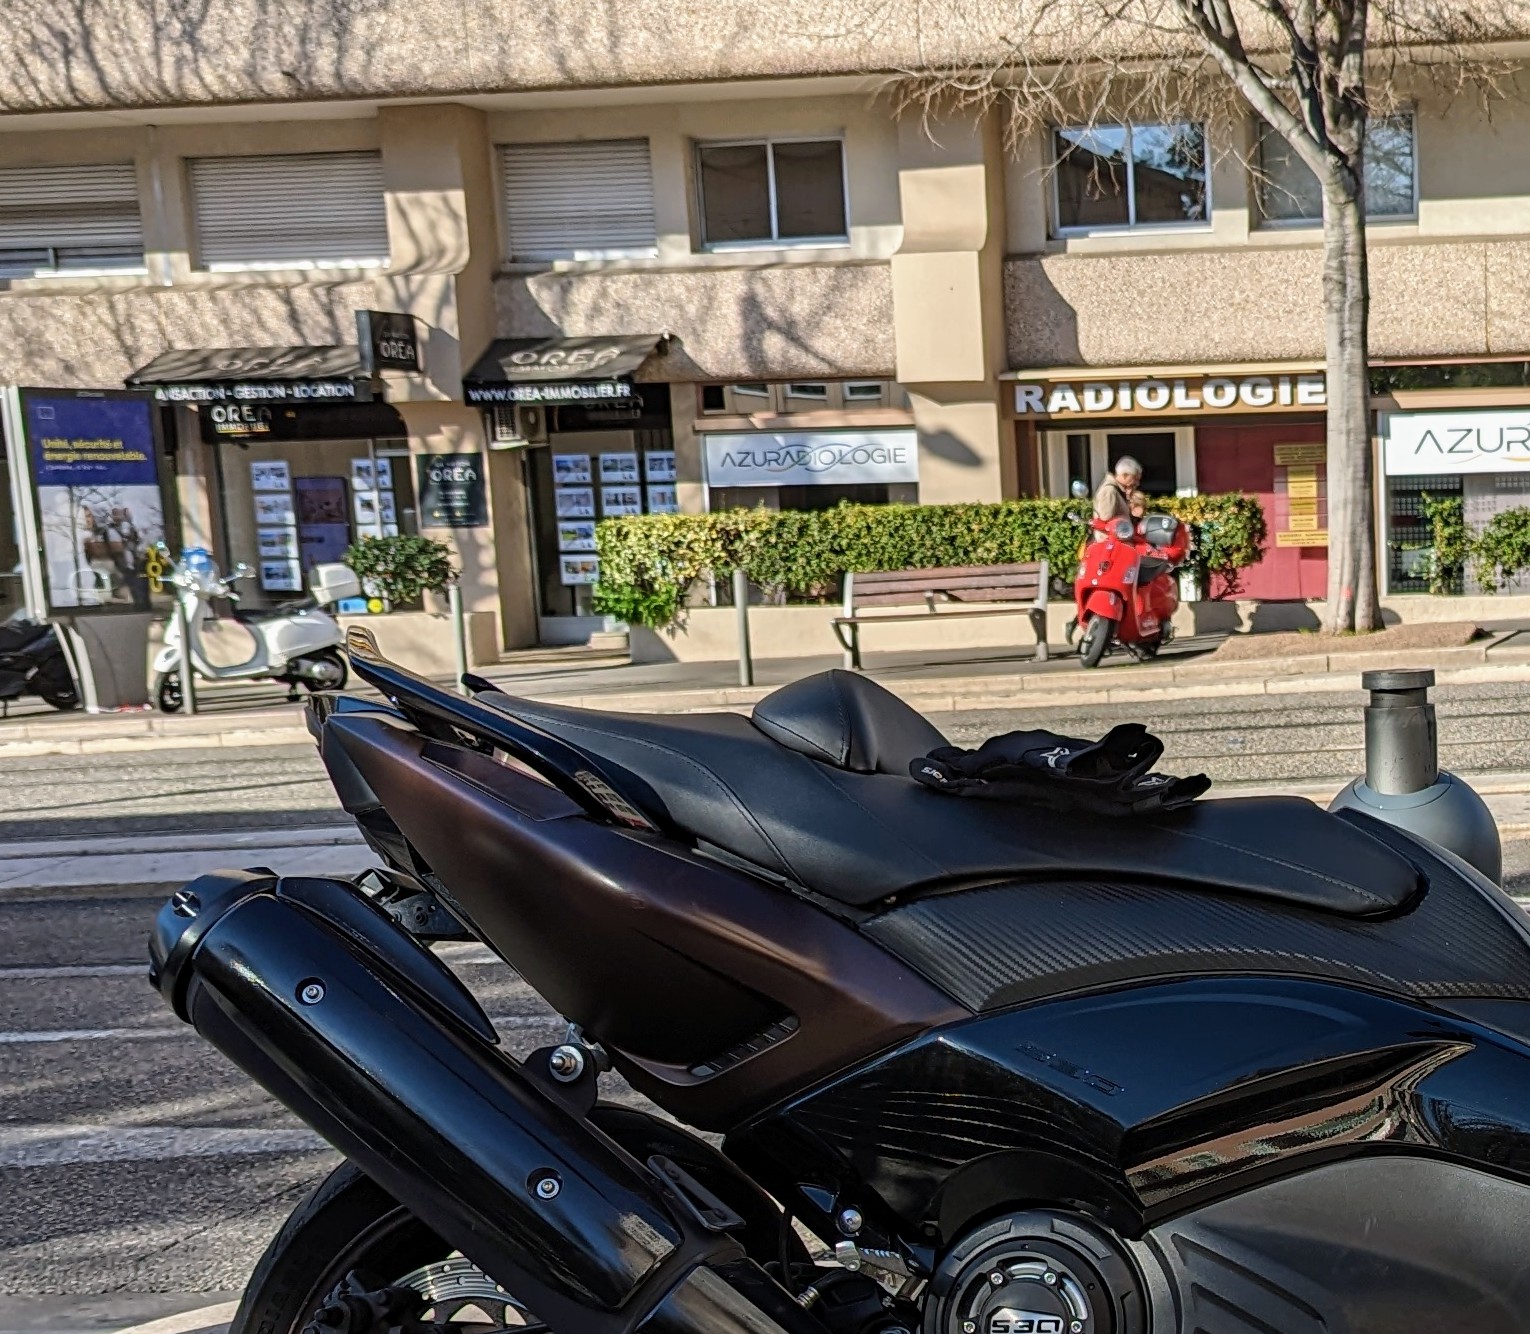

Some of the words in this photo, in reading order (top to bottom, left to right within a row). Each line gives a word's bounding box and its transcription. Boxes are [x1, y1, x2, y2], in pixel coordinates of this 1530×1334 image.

[380, 340, 415, 360] OREA
[509, 347, 622, 366] OREA
[232, 384, 286, 400] GESTION
[292, 382, 356, 399] LOCATION
[1014, 374, 1327, 415] RADIOLOGIE
[210, 404, 273, 424] OREA
[720, 447, 908, 468] AZURADIOLOGIE
[429, 467, 477, 482] OREA
[990, 1318, 1061, 1334] 530
